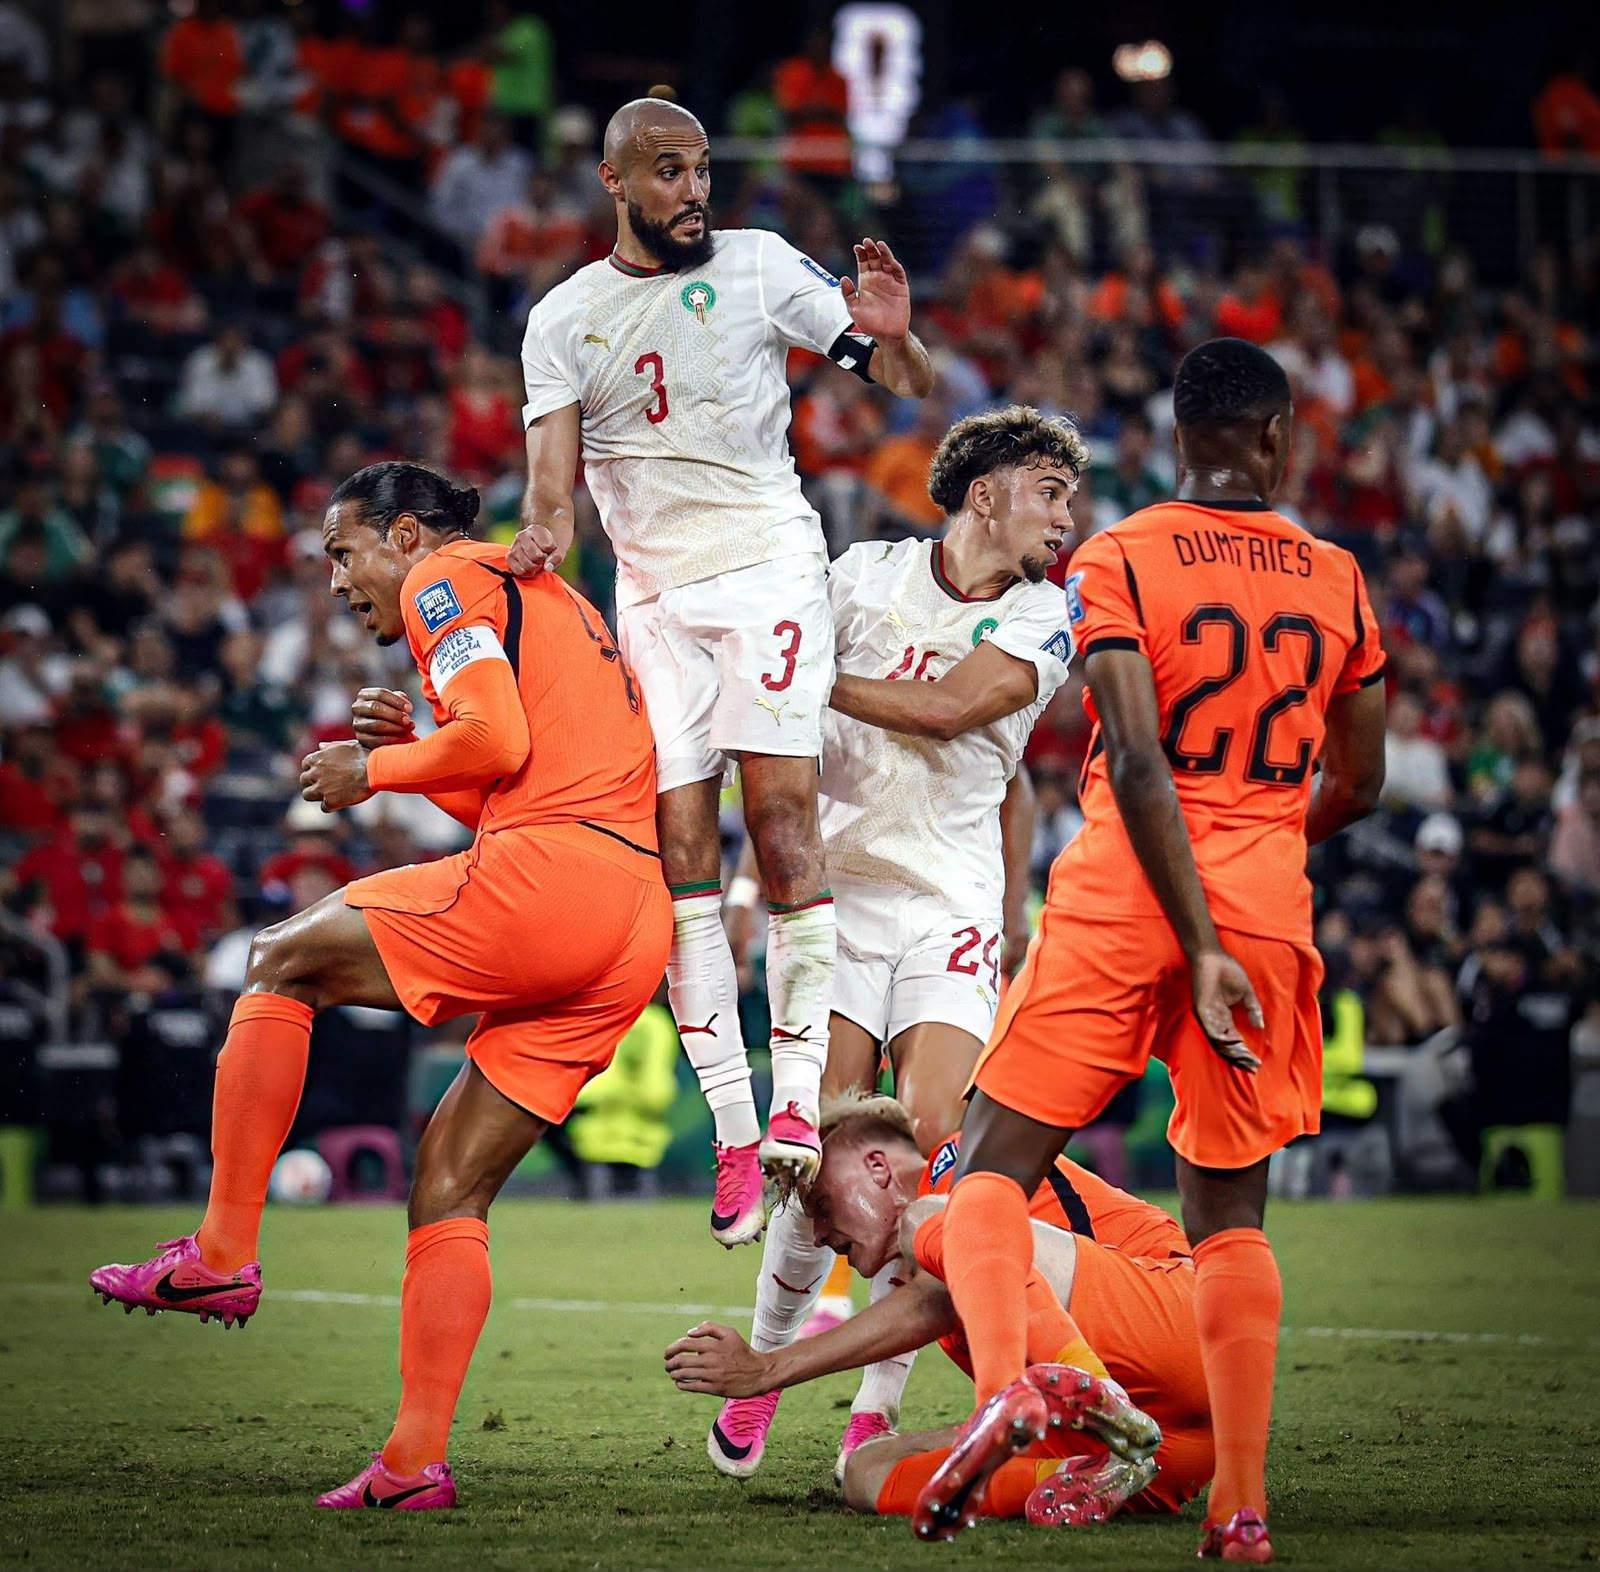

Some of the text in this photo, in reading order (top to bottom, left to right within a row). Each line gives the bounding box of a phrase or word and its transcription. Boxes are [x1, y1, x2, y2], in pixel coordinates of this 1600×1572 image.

[634, 351, 669, 424] 3
[423, 593, 449, 611] UNITES
[437, 631, 473, 667] UNITES
[450, 640, 481, 661] World
[761, 620, 802, 692] 3
[1160, 603, 1324, 787] 22
